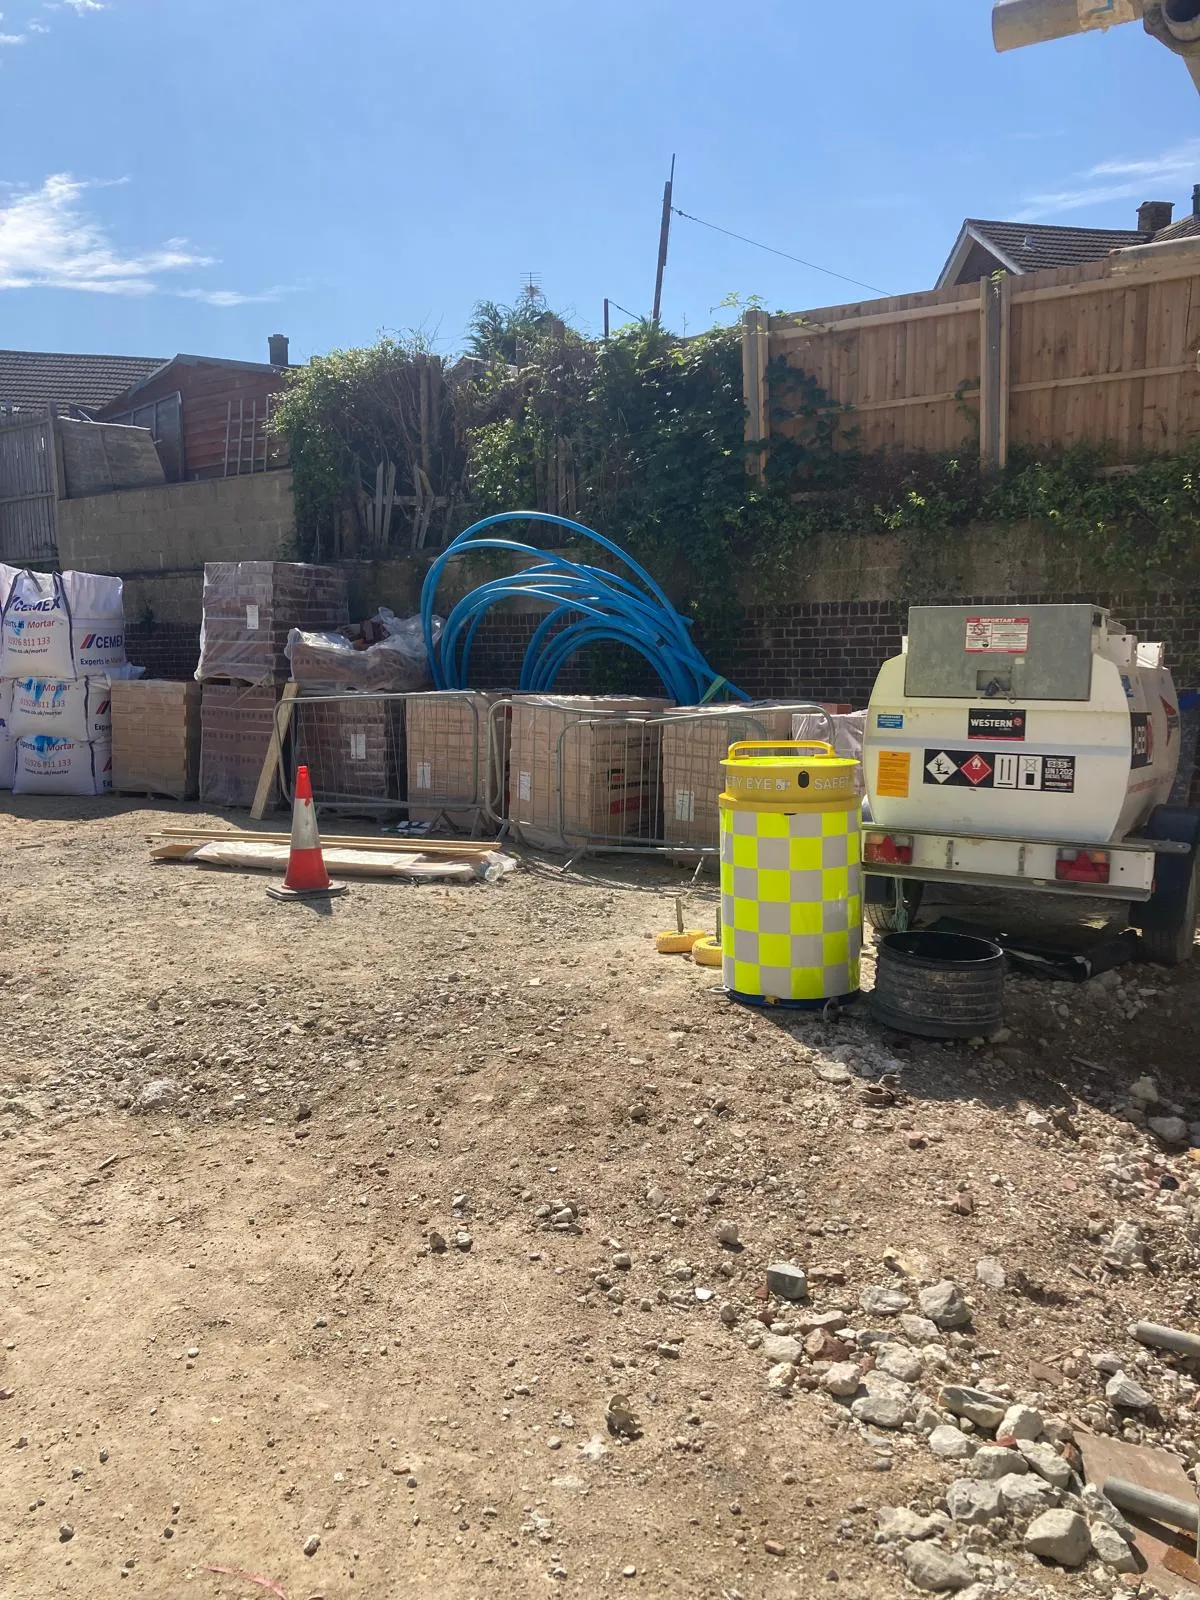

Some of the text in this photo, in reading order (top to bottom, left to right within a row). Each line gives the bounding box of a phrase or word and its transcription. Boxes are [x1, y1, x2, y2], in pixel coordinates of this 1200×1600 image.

[14, 597, 61, 612] CEMEX
[28, 620, 56, 629] Mortar
[38, 636, 51, 646] 133
[80, 657, 104, 666] Experts
[43, 682, 71, 692] Mortar
[970, 718, 1013, 728] WESTERN
[47, 742, 75, 752] Mortar
[58, 759, 71, 768] 133
[747, 777, 773, 790] EYE
